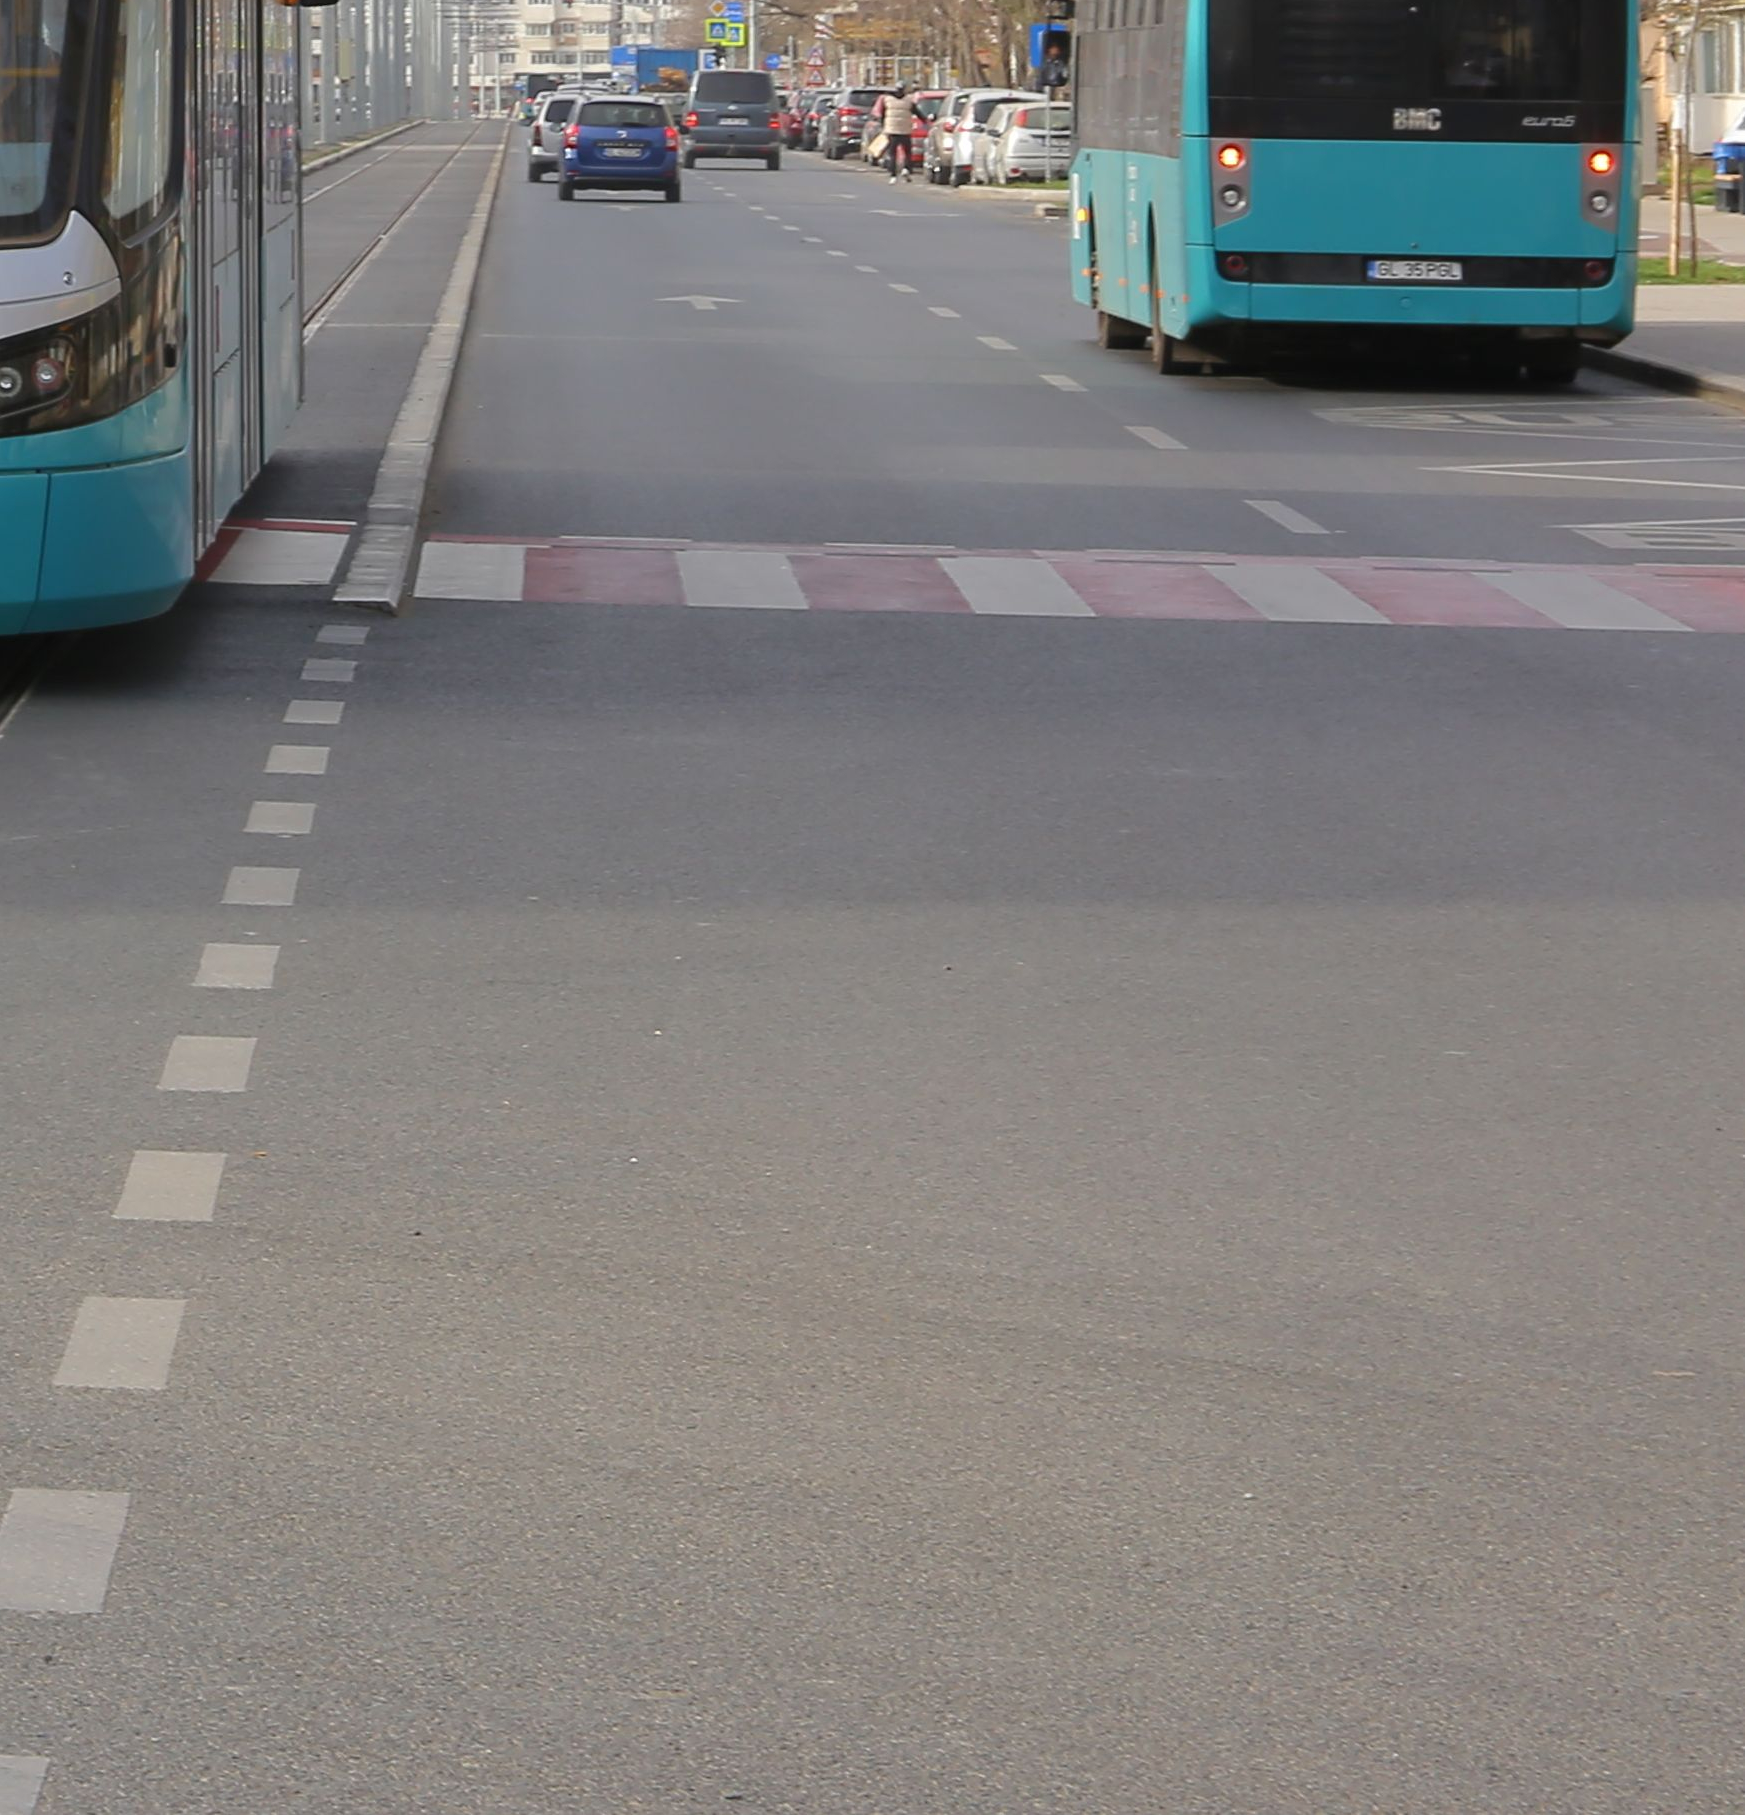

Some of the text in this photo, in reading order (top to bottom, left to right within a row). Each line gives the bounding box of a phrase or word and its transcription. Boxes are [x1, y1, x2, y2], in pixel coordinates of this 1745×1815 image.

[1392, 107, 1443, 131] BMC
[1521, 115, 1577, 128] euro6
[1378, 262, 1399, 278] GL
